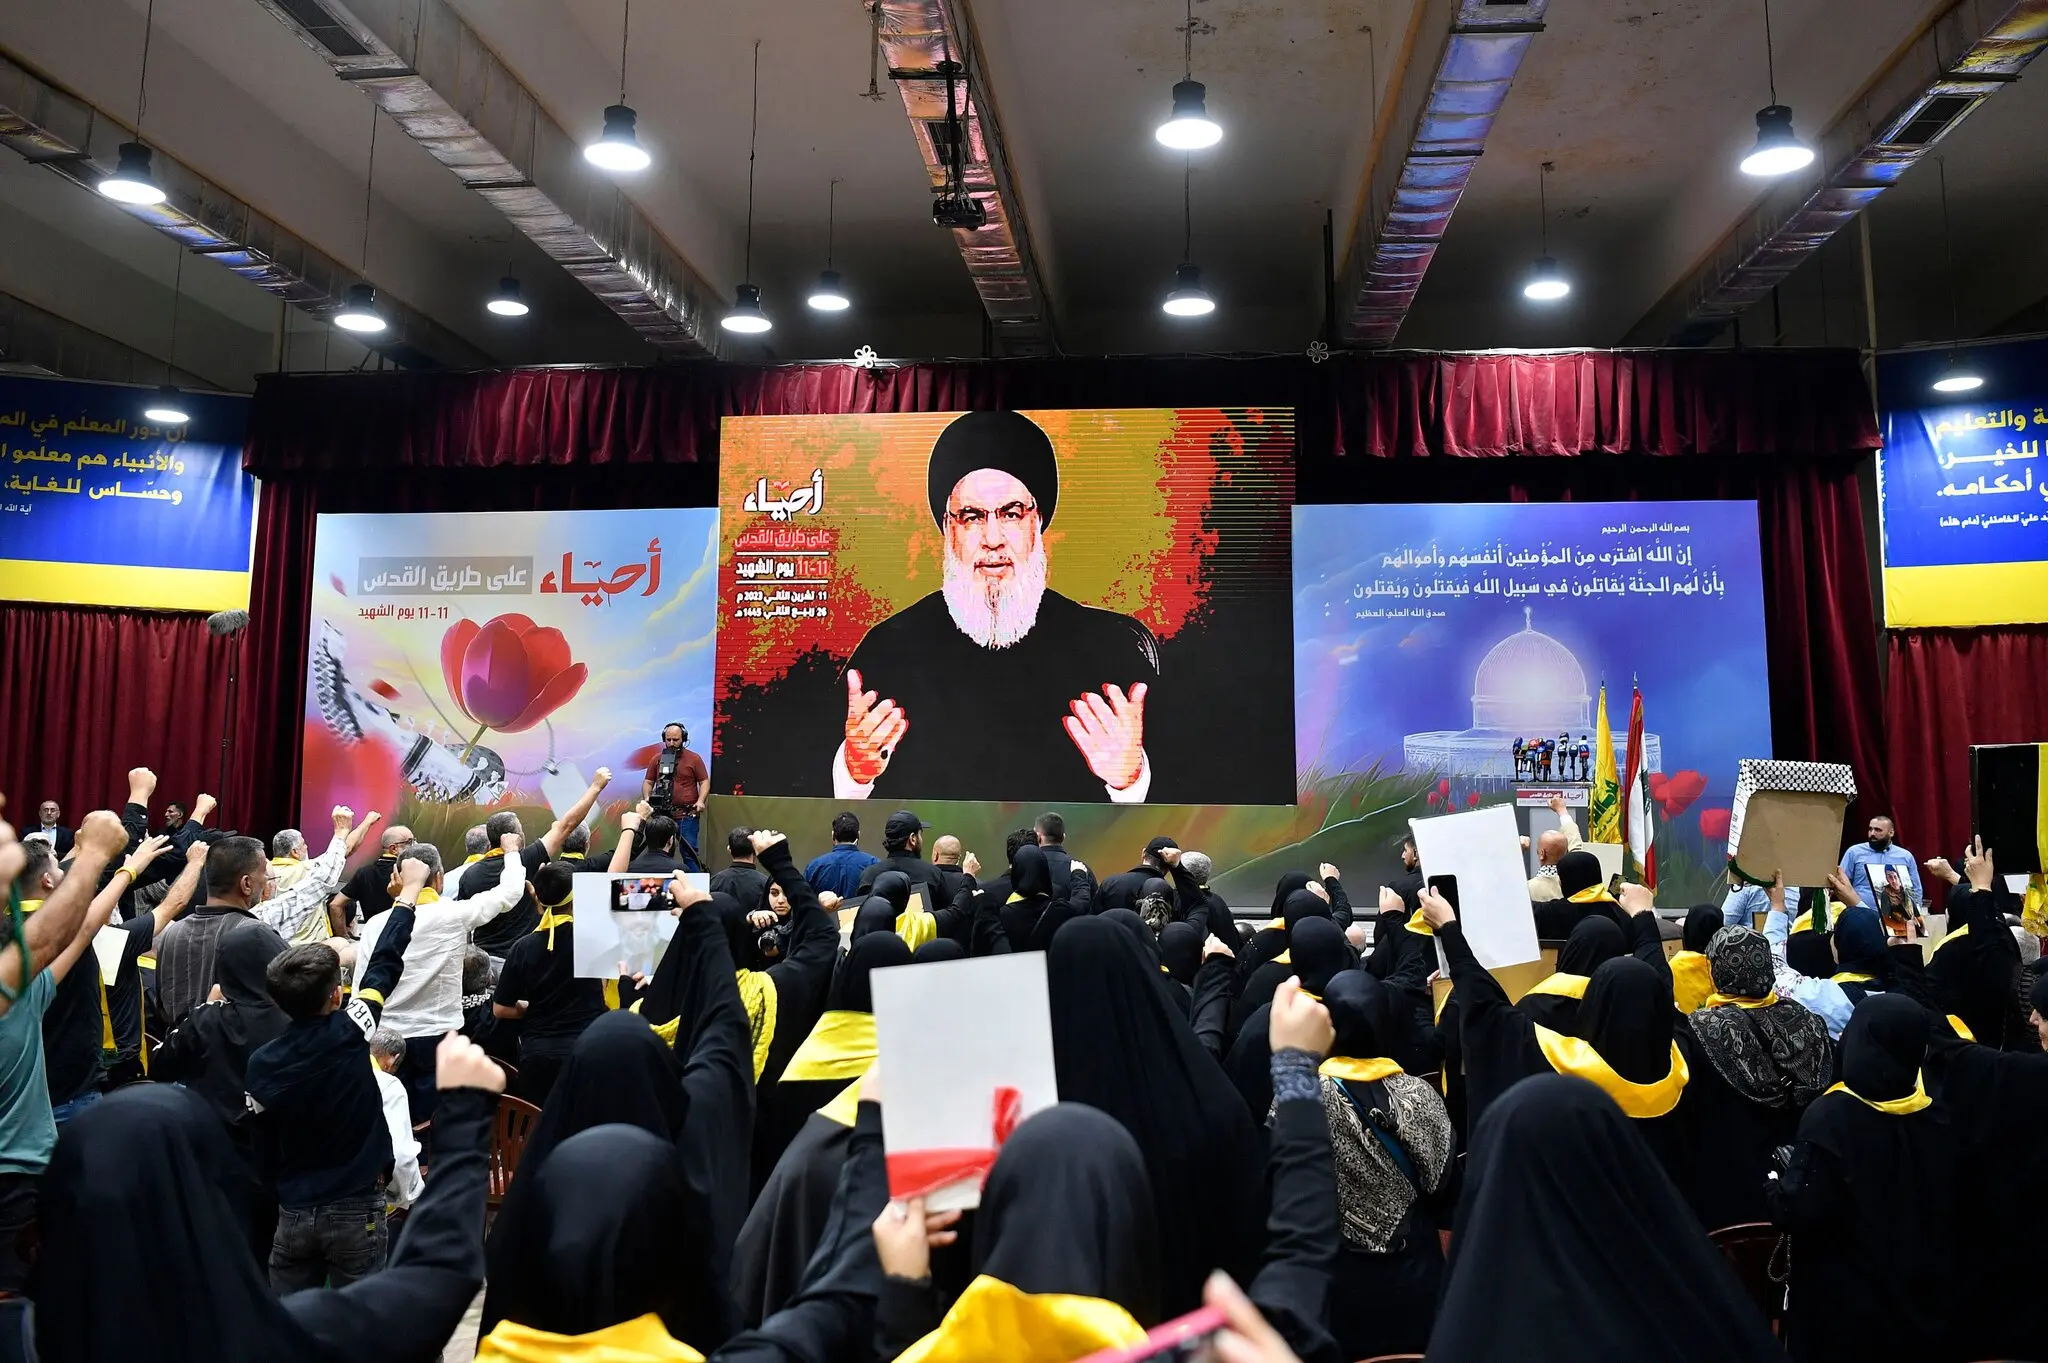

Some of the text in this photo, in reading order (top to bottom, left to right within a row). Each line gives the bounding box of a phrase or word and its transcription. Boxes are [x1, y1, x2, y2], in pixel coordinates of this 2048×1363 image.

[31, 414, 58, 437] في
[128, 424, 161, 440] دور
[1935, 409, 2027, 440] والتعليم
[77, 453, 108, 470] هم
[113, 450, 185, 475] والأنبياء
[1938, 440, 2038, 469] للخير
[1601, 522, 1690, 534] بسم الله الرحمن الرحيم
[734, 529, 774, 548] القدس
[735, 558, 774, 578] الشهيد
[775, 562, 795, 578] يوم
[363, 565, 527, 592] على طريق القدس
[358, 604, 448, 620] 11-11 يوم الشهيد
[1355, 608, 1385, 619] العظيم
[1410, 608, 1424, 617] الله
[1425, 609, 1446, 618] صدق
